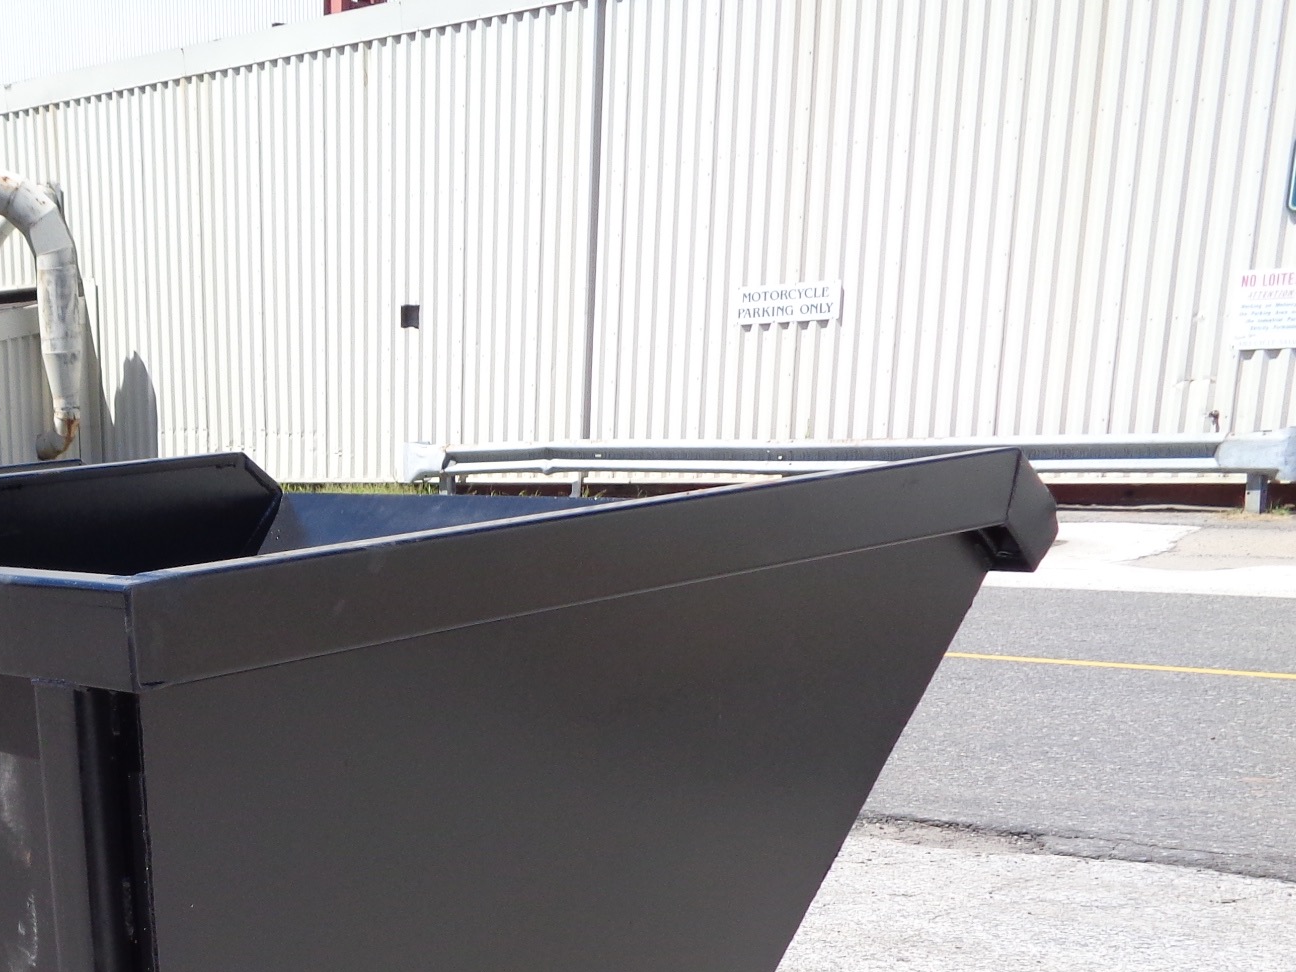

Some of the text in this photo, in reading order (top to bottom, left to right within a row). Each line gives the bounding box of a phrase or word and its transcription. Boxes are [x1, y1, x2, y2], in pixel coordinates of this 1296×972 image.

[1241, 271, 1296, 287] NO LOITE
[742, 286, 830, 303] MOTORCYCLE
[737, 302, 834, 319] PARKING ONLY
